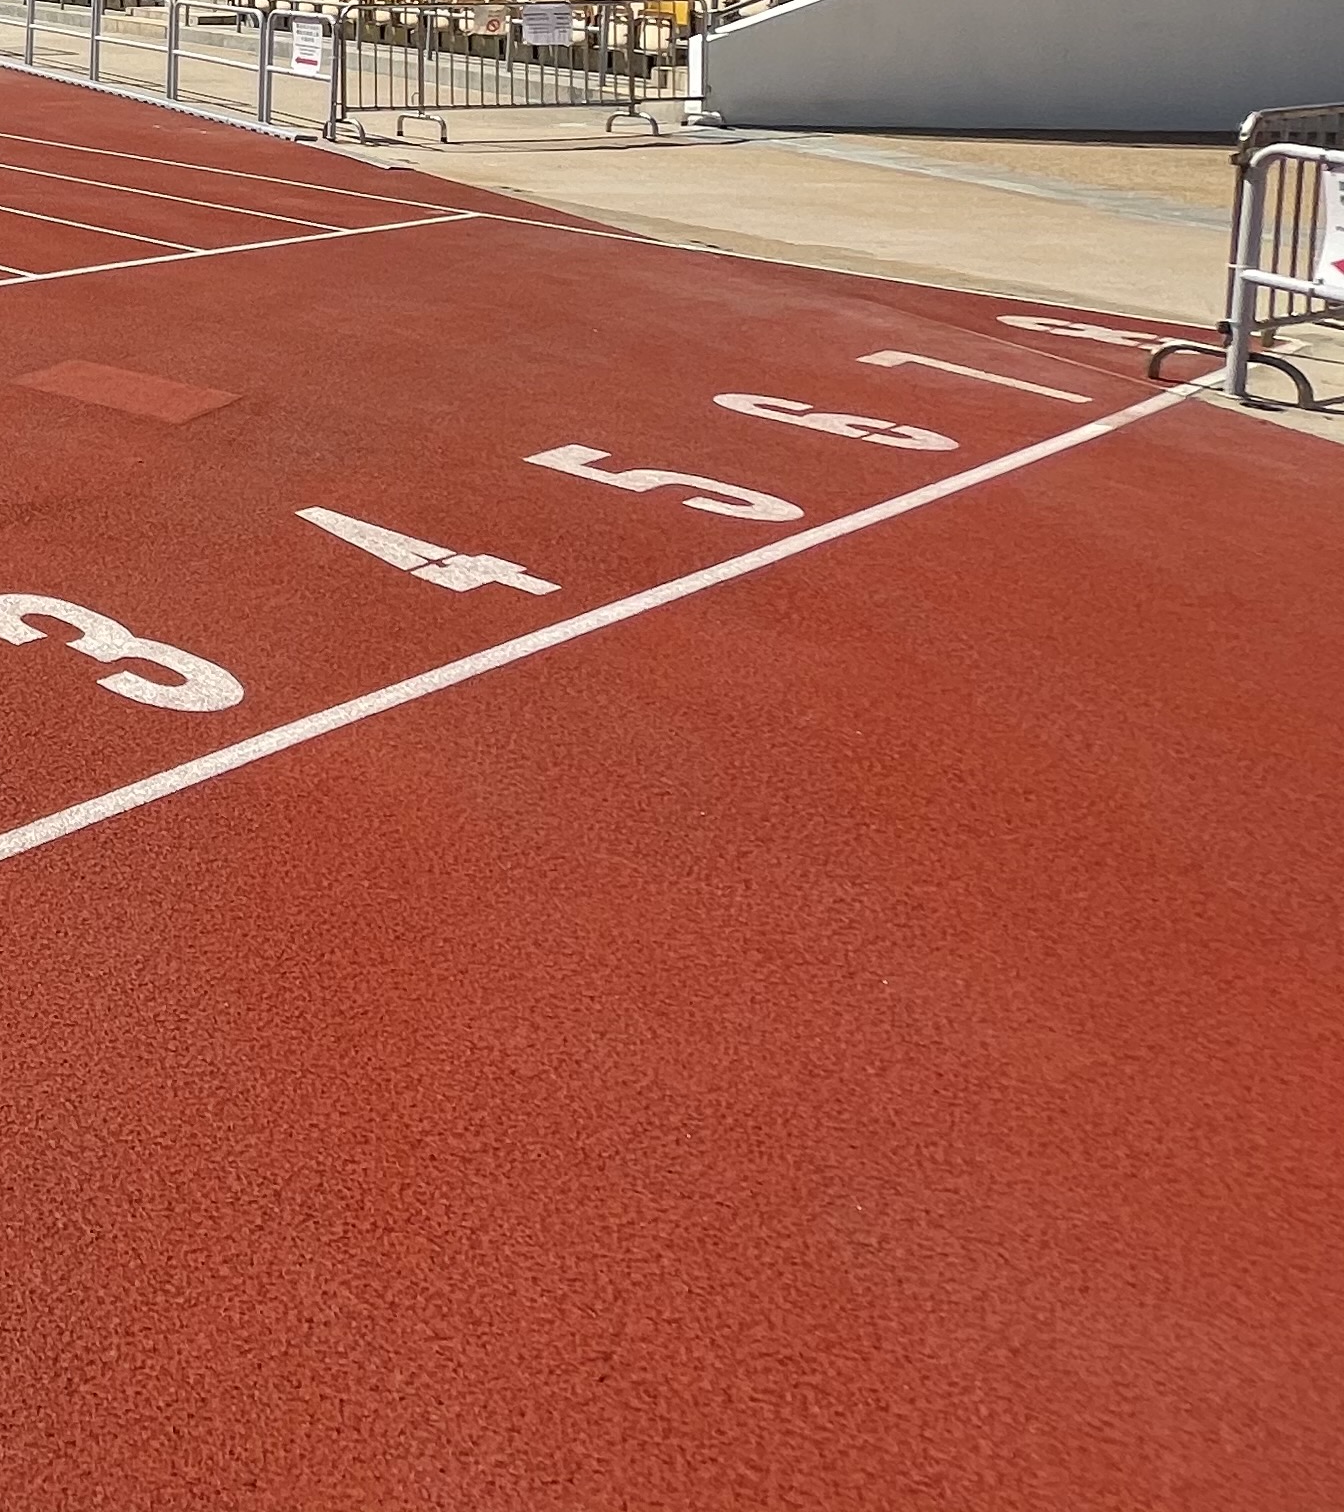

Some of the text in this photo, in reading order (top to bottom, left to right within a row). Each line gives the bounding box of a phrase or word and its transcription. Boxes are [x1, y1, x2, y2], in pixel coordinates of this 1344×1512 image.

[996, 314, 1203, 355] 8
[855, 350, 1093, 403] 7
[712, 393, 960, 451] 6
[523, 444, 805, 522] 5
[294, 506, 562, 596] 4
